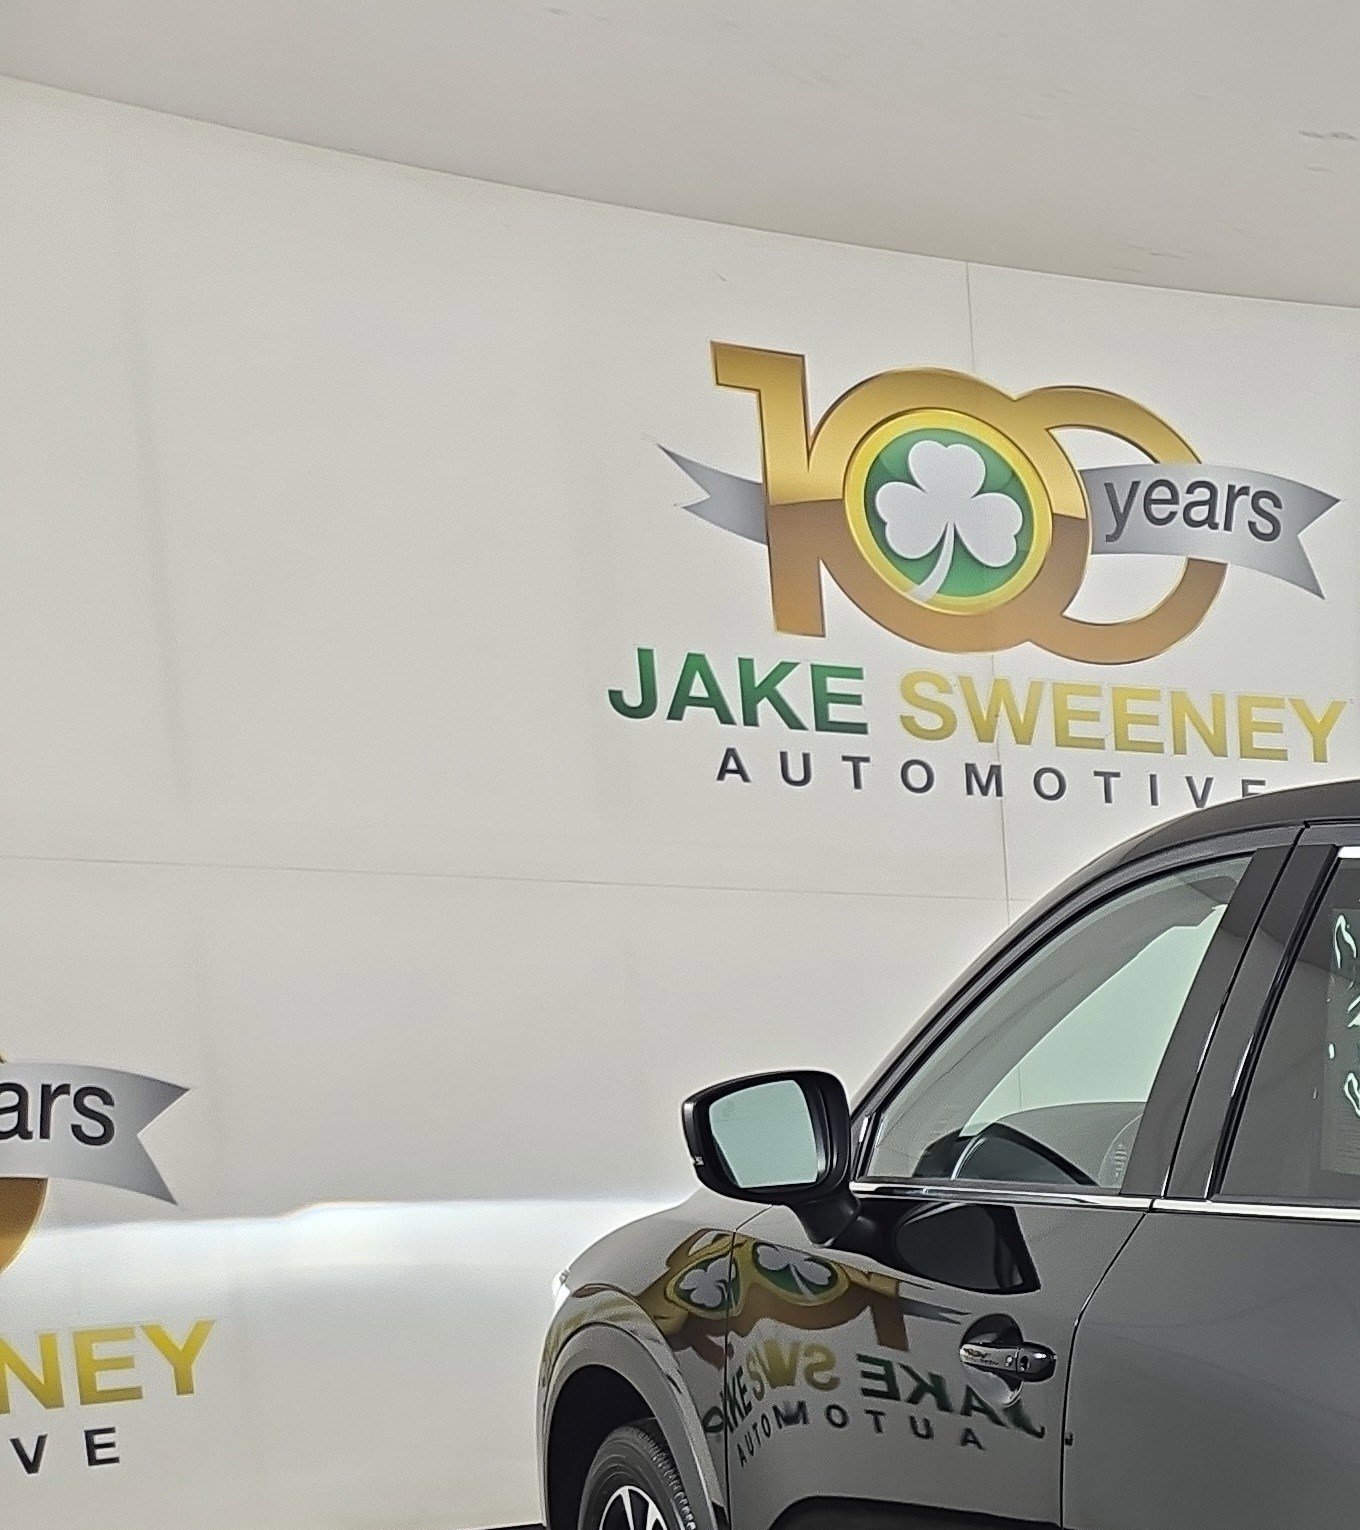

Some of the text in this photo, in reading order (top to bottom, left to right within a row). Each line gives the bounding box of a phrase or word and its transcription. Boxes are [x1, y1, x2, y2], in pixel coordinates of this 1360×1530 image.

[1104, 477, 1284, 544] years
[607, 647, 1347, 764] JAKE SWEENEY
